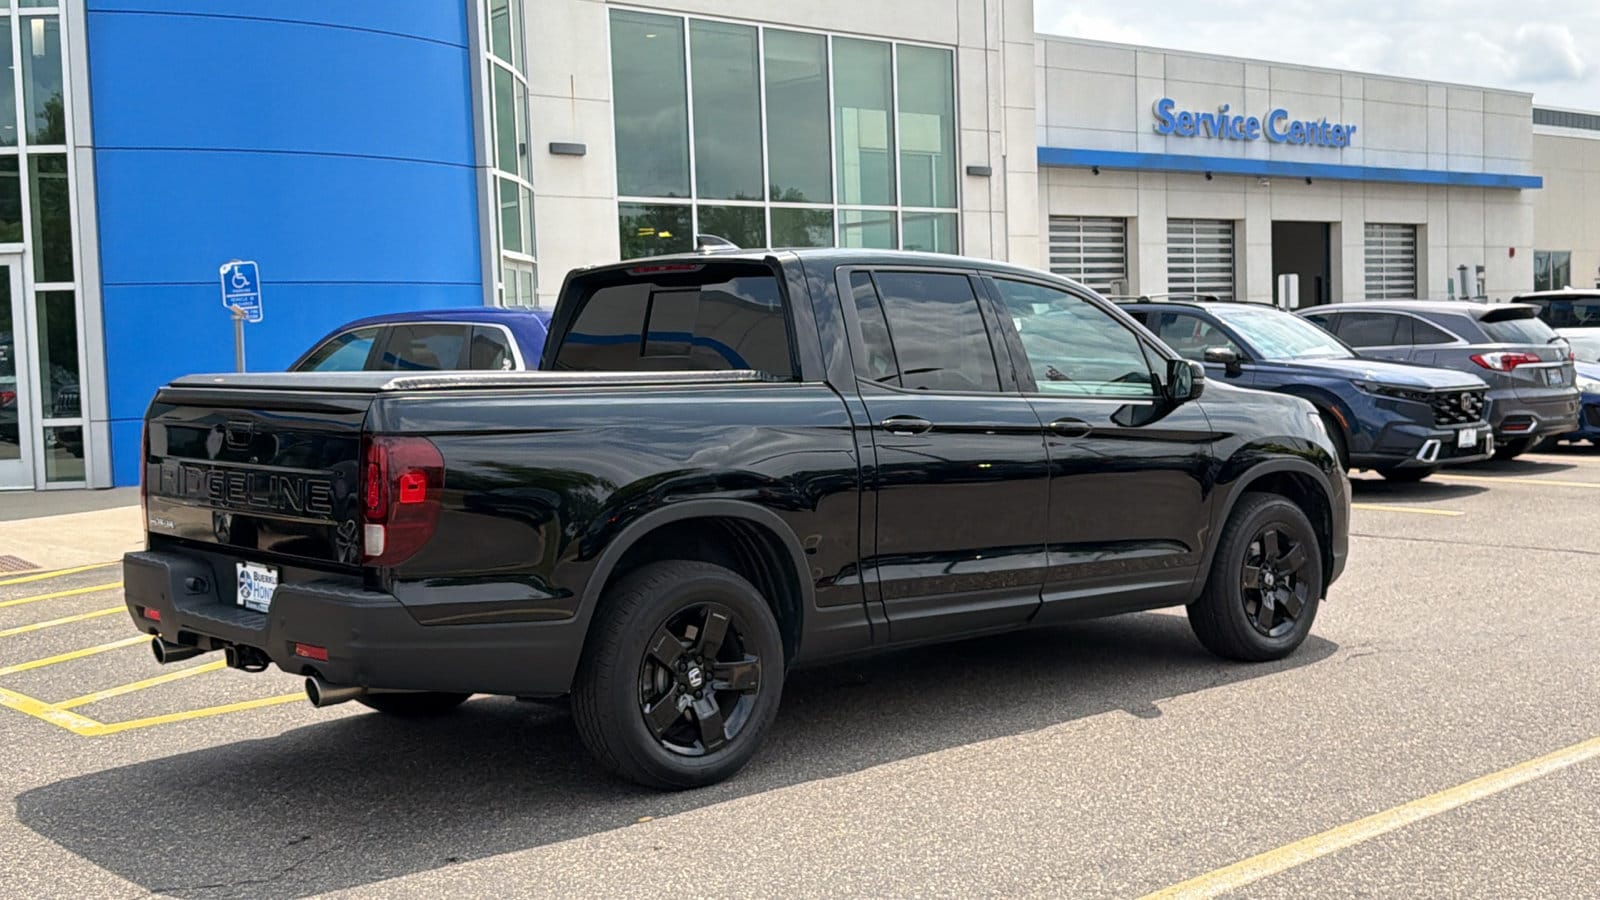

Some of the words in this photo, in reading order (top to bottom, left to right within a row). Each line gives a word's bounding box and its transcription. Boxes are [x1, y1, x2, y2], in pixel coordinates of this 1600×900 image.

[1153, 98, 1261, 141] Service
[1264, 108, 1357, 149] Center
[159, 463, 332, 514] RIDGELINE
